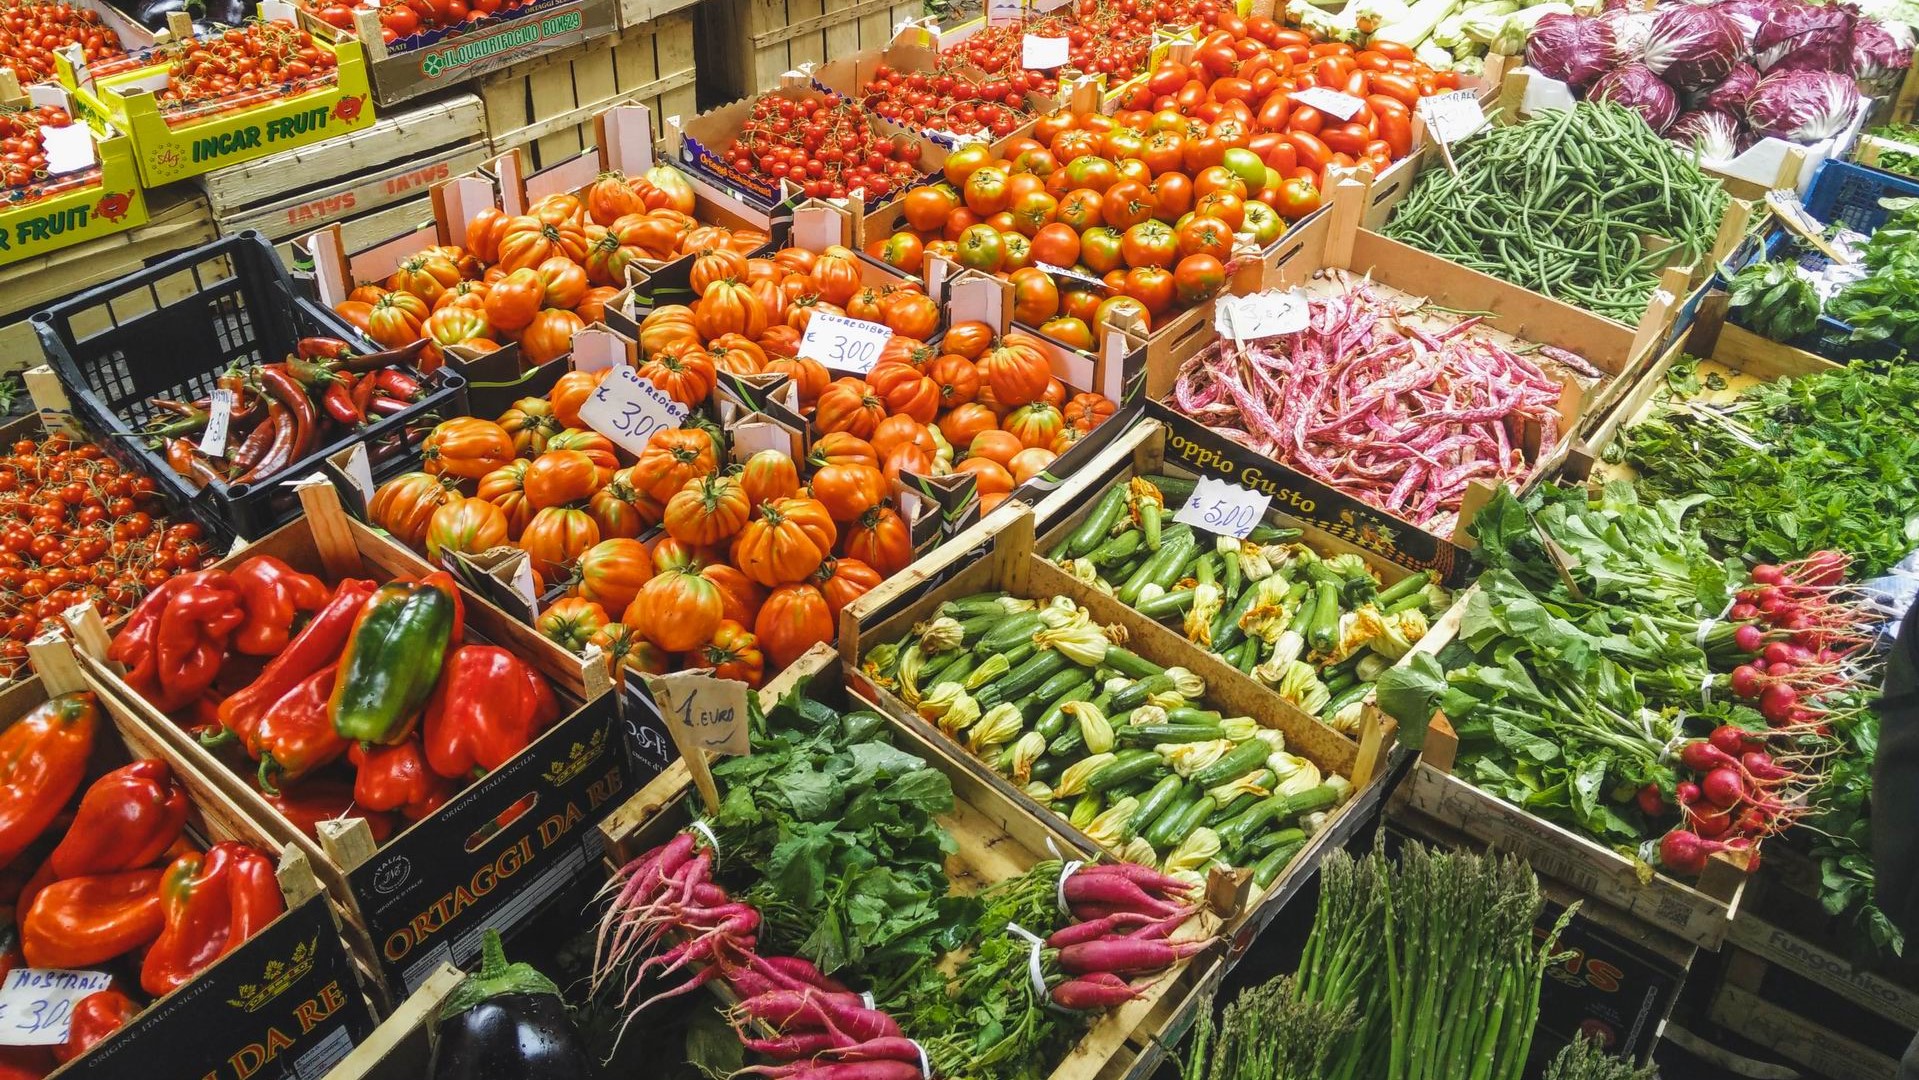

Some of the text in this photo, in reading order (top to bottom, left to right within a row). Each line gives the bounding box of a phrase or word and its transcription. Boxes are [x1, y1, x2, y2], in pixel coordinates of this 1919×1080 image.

[457, 23, 540, 63] QUADRIFOGLIO
[192, 106, 329, 163] INCAR FRUIT
[287, 162, 449, 225] SALVI SALVI
[16, 204, 90, 245] FRUIT
[829, 335, 874, 363] 3,00
[1241, 467, 1316, 513] Gusto
[1203, 500, 1254, 529] 5,00
[701, 706, 735, 727] EURO
[441, 792, 481, 822] ORIGINE
[383, 835, 536, 961] ORTAGGI
[537, 801, 586, 849] DA
[586, 766, 624, 809] RE
[88, 1030, 138, 1068] ORIGINE
[227, 1023, 297, 1080] DA
[292, 980, 349, 1036] RE
